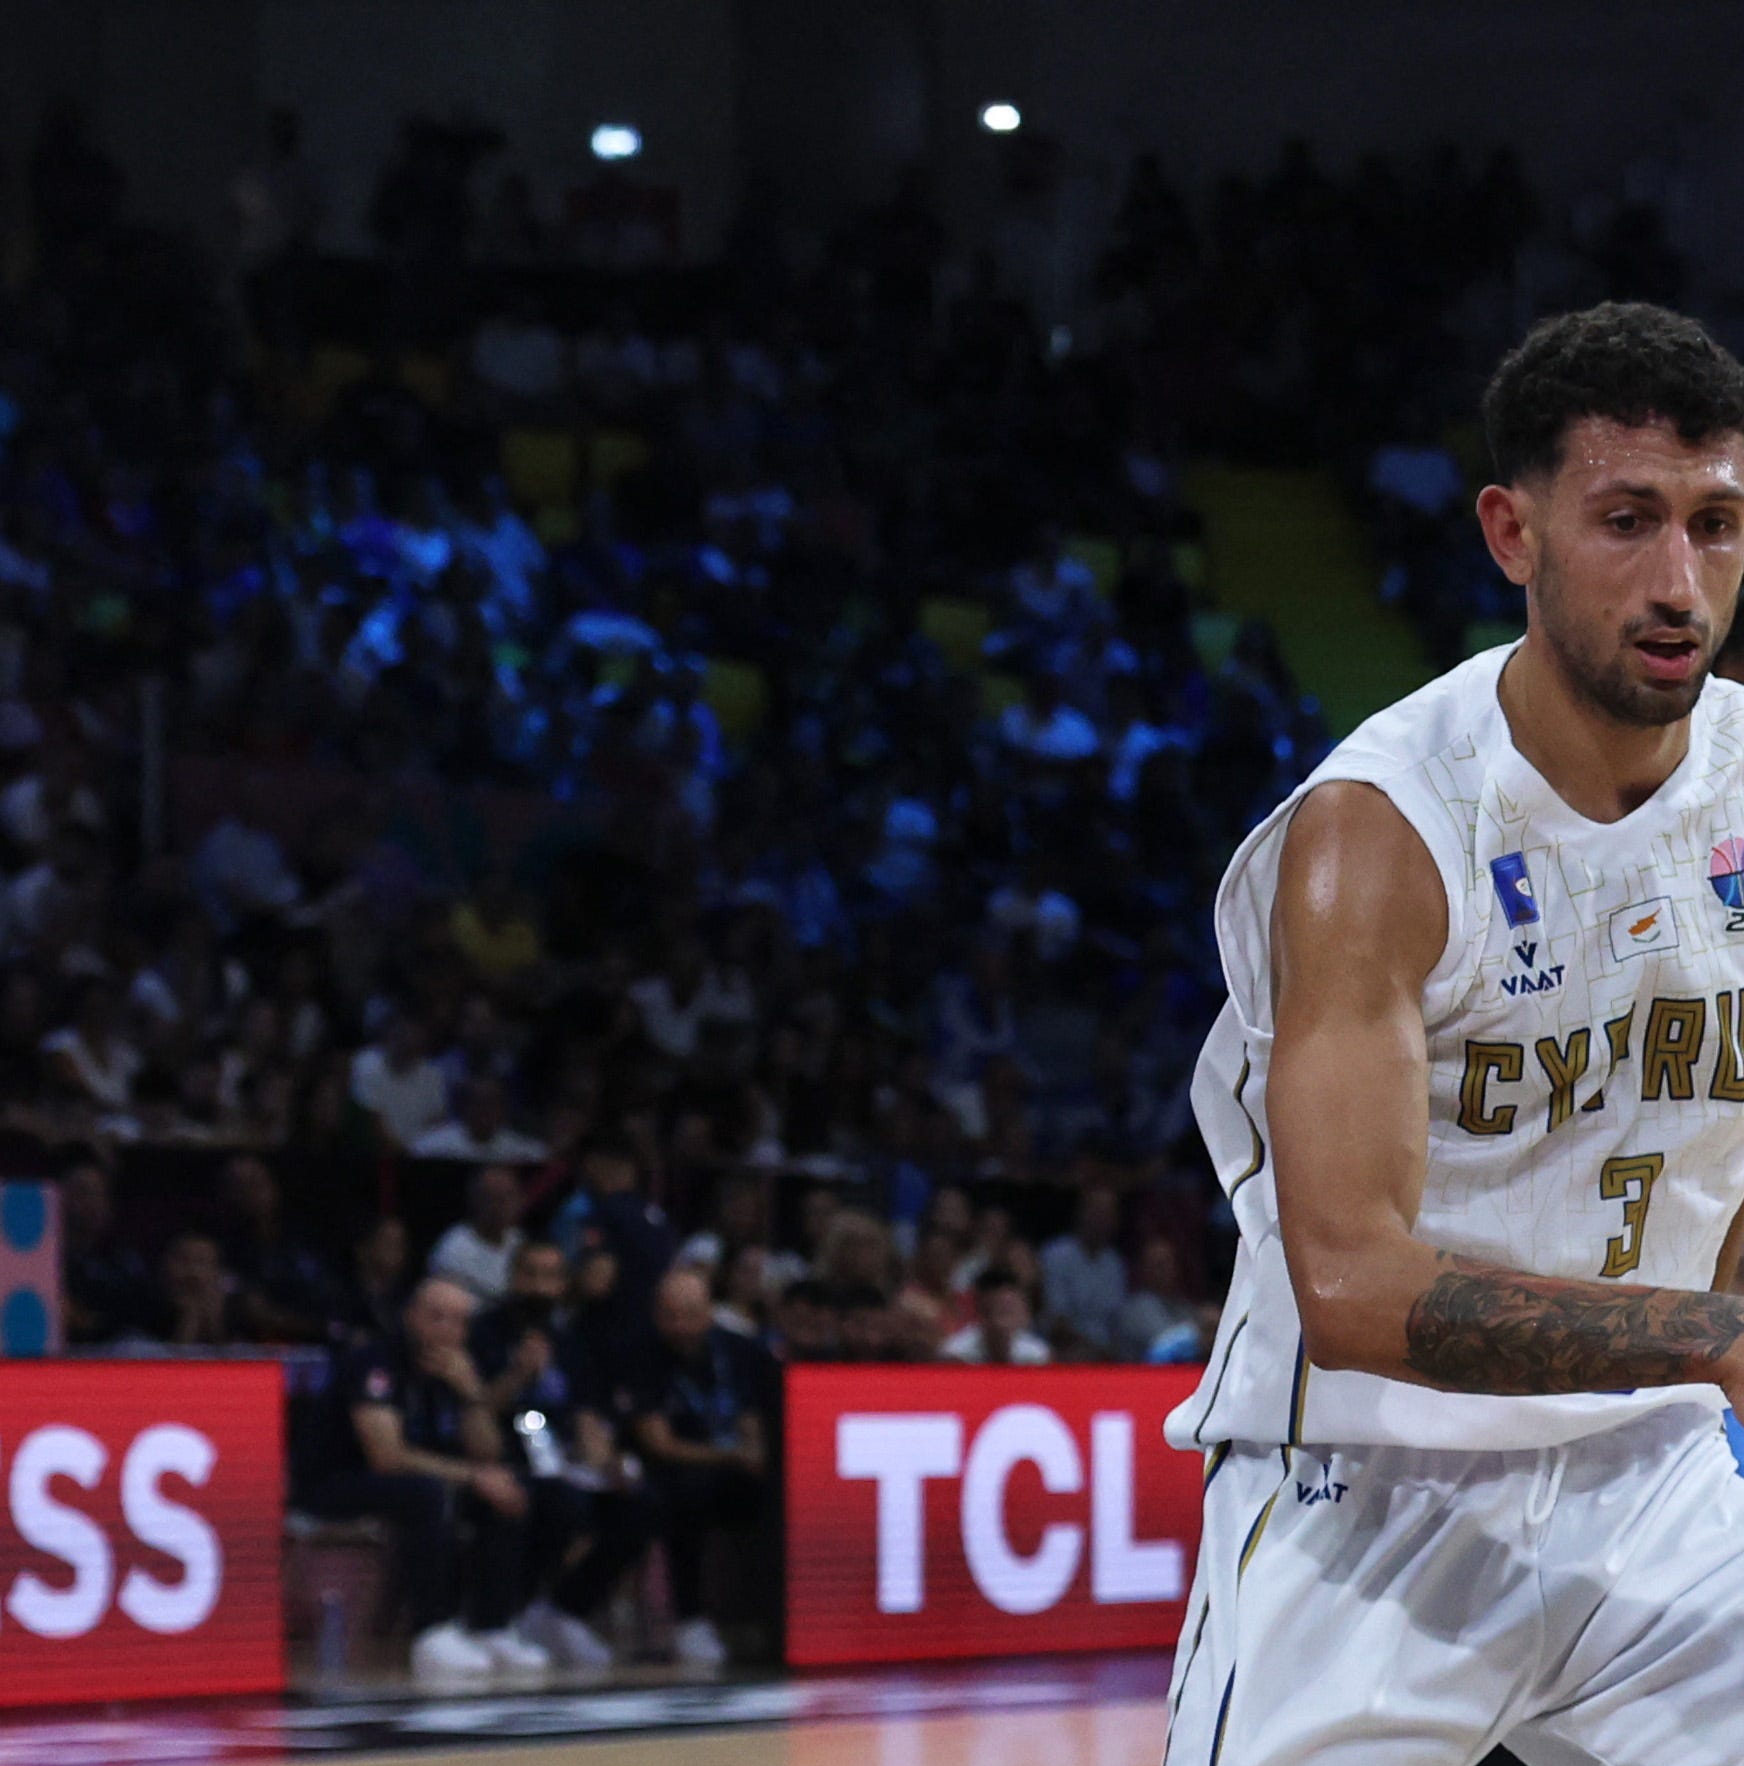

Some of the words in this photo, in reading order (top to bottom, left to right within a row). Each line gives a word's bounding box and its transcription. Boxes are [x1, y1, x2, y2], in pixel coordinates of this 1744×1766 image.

[1500, 964, 1566, 997] VAAT
[1599, 1152, 1665, 1278] 3
[0, 1421, 225, 1640] SS
[835, 1402, 1187, 1616] TCL
